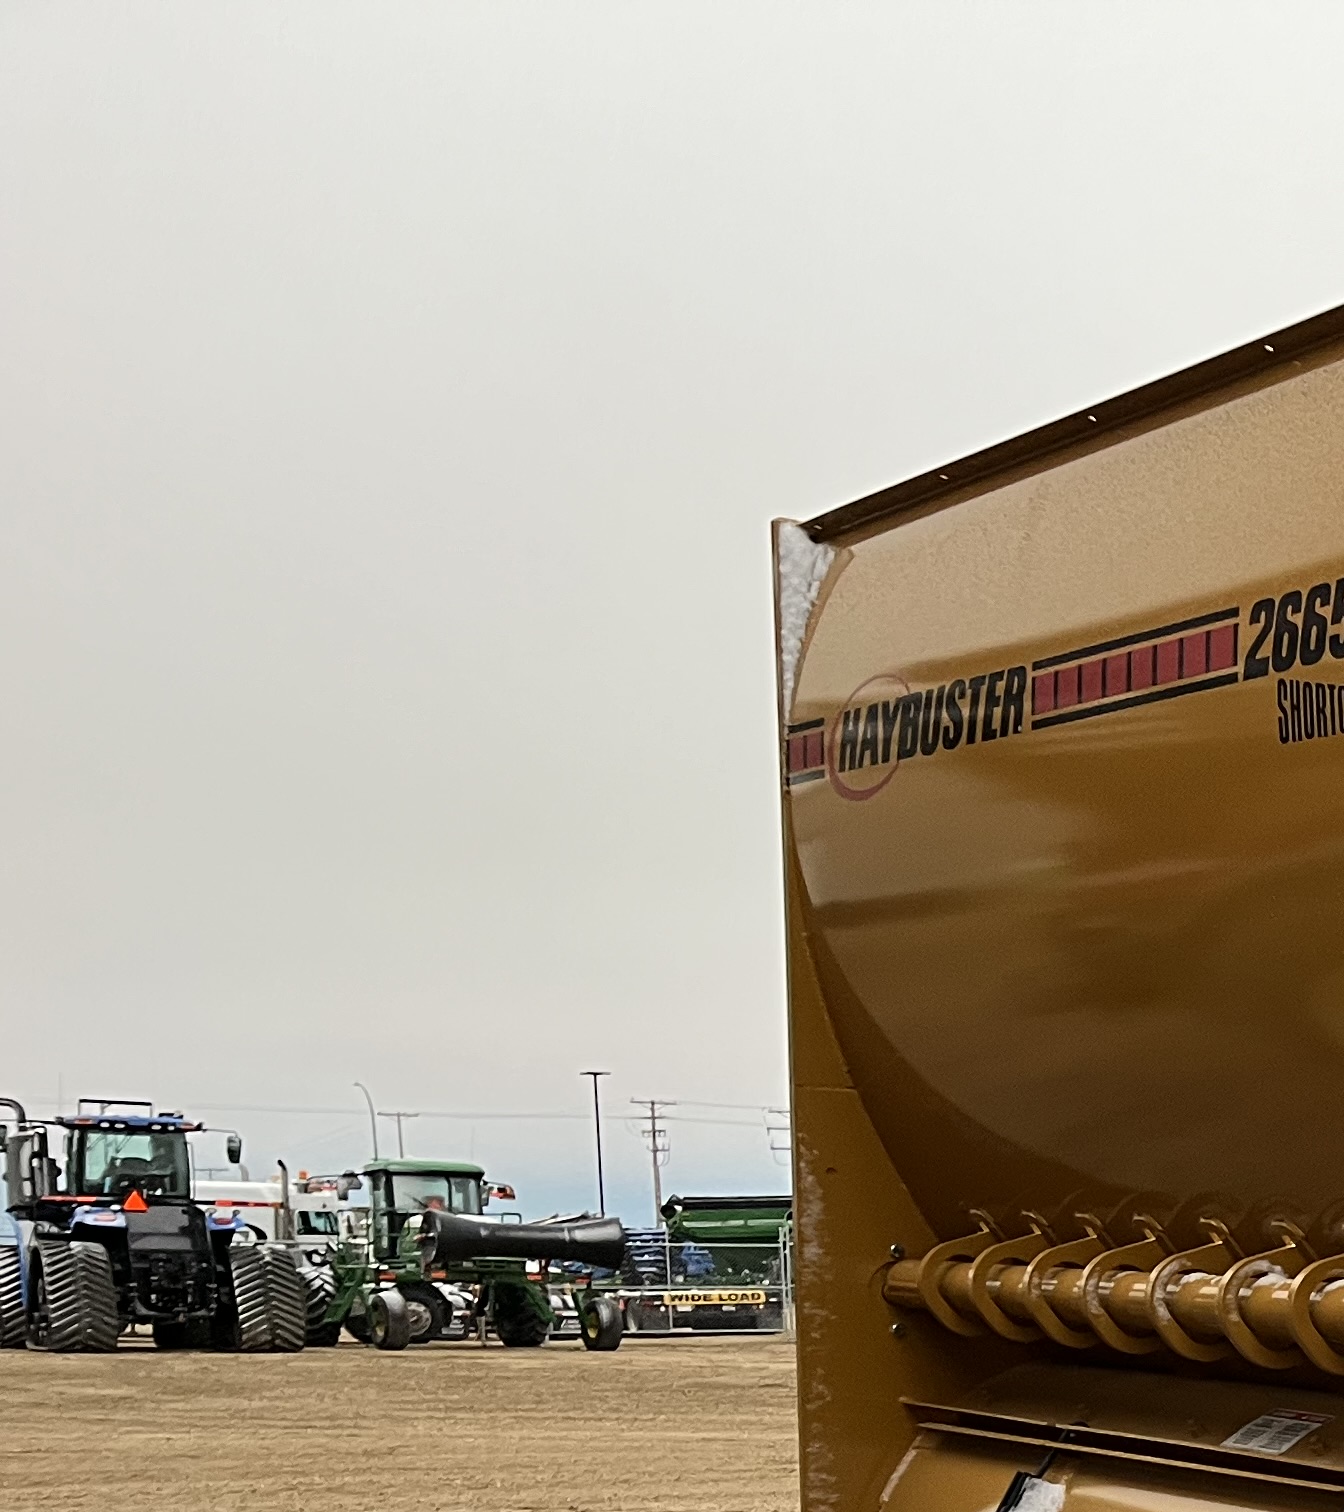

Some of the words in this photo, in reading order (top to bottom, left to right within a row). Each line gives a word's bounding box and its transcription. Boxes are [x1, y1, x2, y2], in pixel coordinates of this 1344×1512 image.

[838, 665, 1028, 773] HAYBUSTER
[670, 1294, 714, 1302] WIDE
[719, 1293, 761, 1302] LOAD
